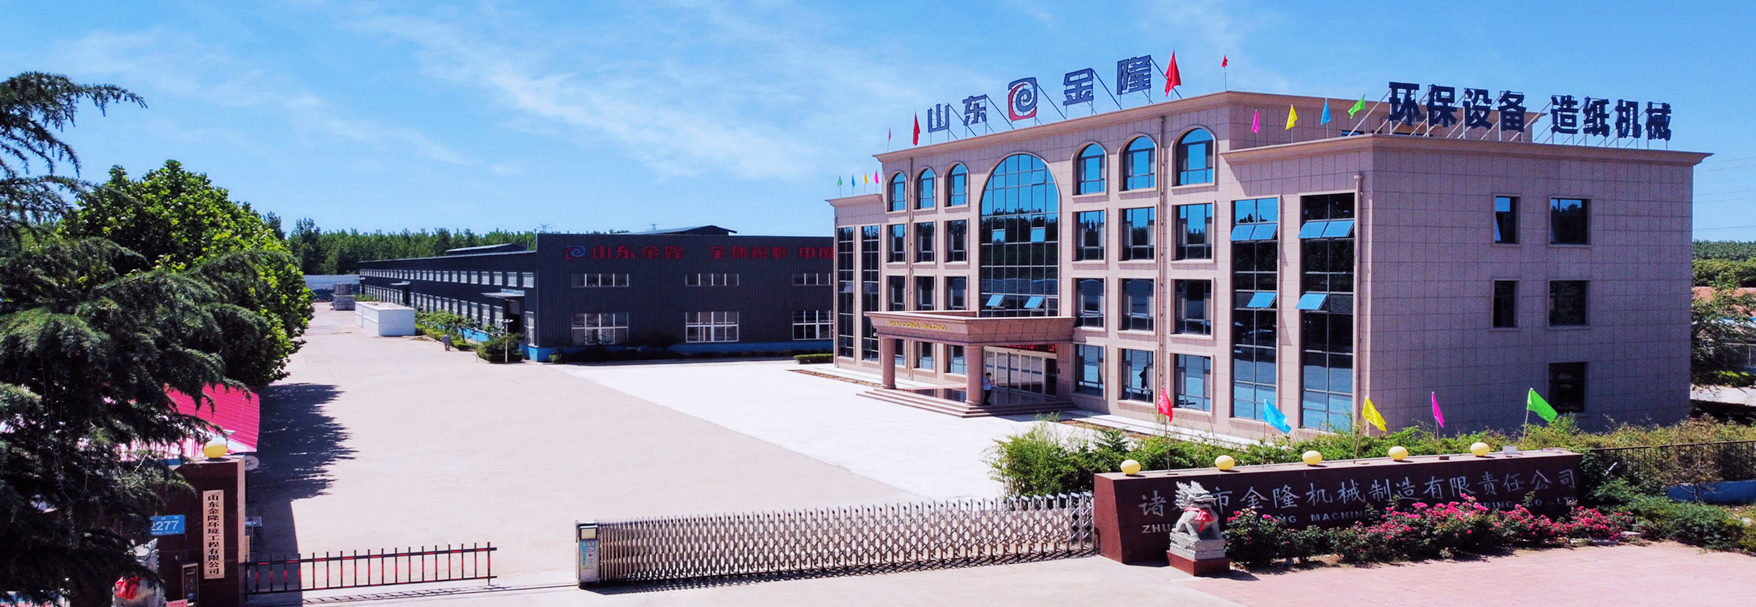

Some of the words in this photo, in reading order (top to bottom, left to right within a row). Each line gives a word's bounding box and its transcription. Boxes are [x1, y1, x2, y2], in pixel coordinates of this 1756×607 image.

[928, 95, 988, 133] 山东
[1063, 55, 1152, 106] 金隆
[1388, 81, 1527, 133] 环保设备
[1551, 94, 1672, 141] 造纸机械
[592, 245, 684, 259] 山东金隆
[1138, 469, 1577, 517] 诸市金隆机械制造有限责任公司
[207, 494, 220, 575] 山东金隆环境工程有限公司
